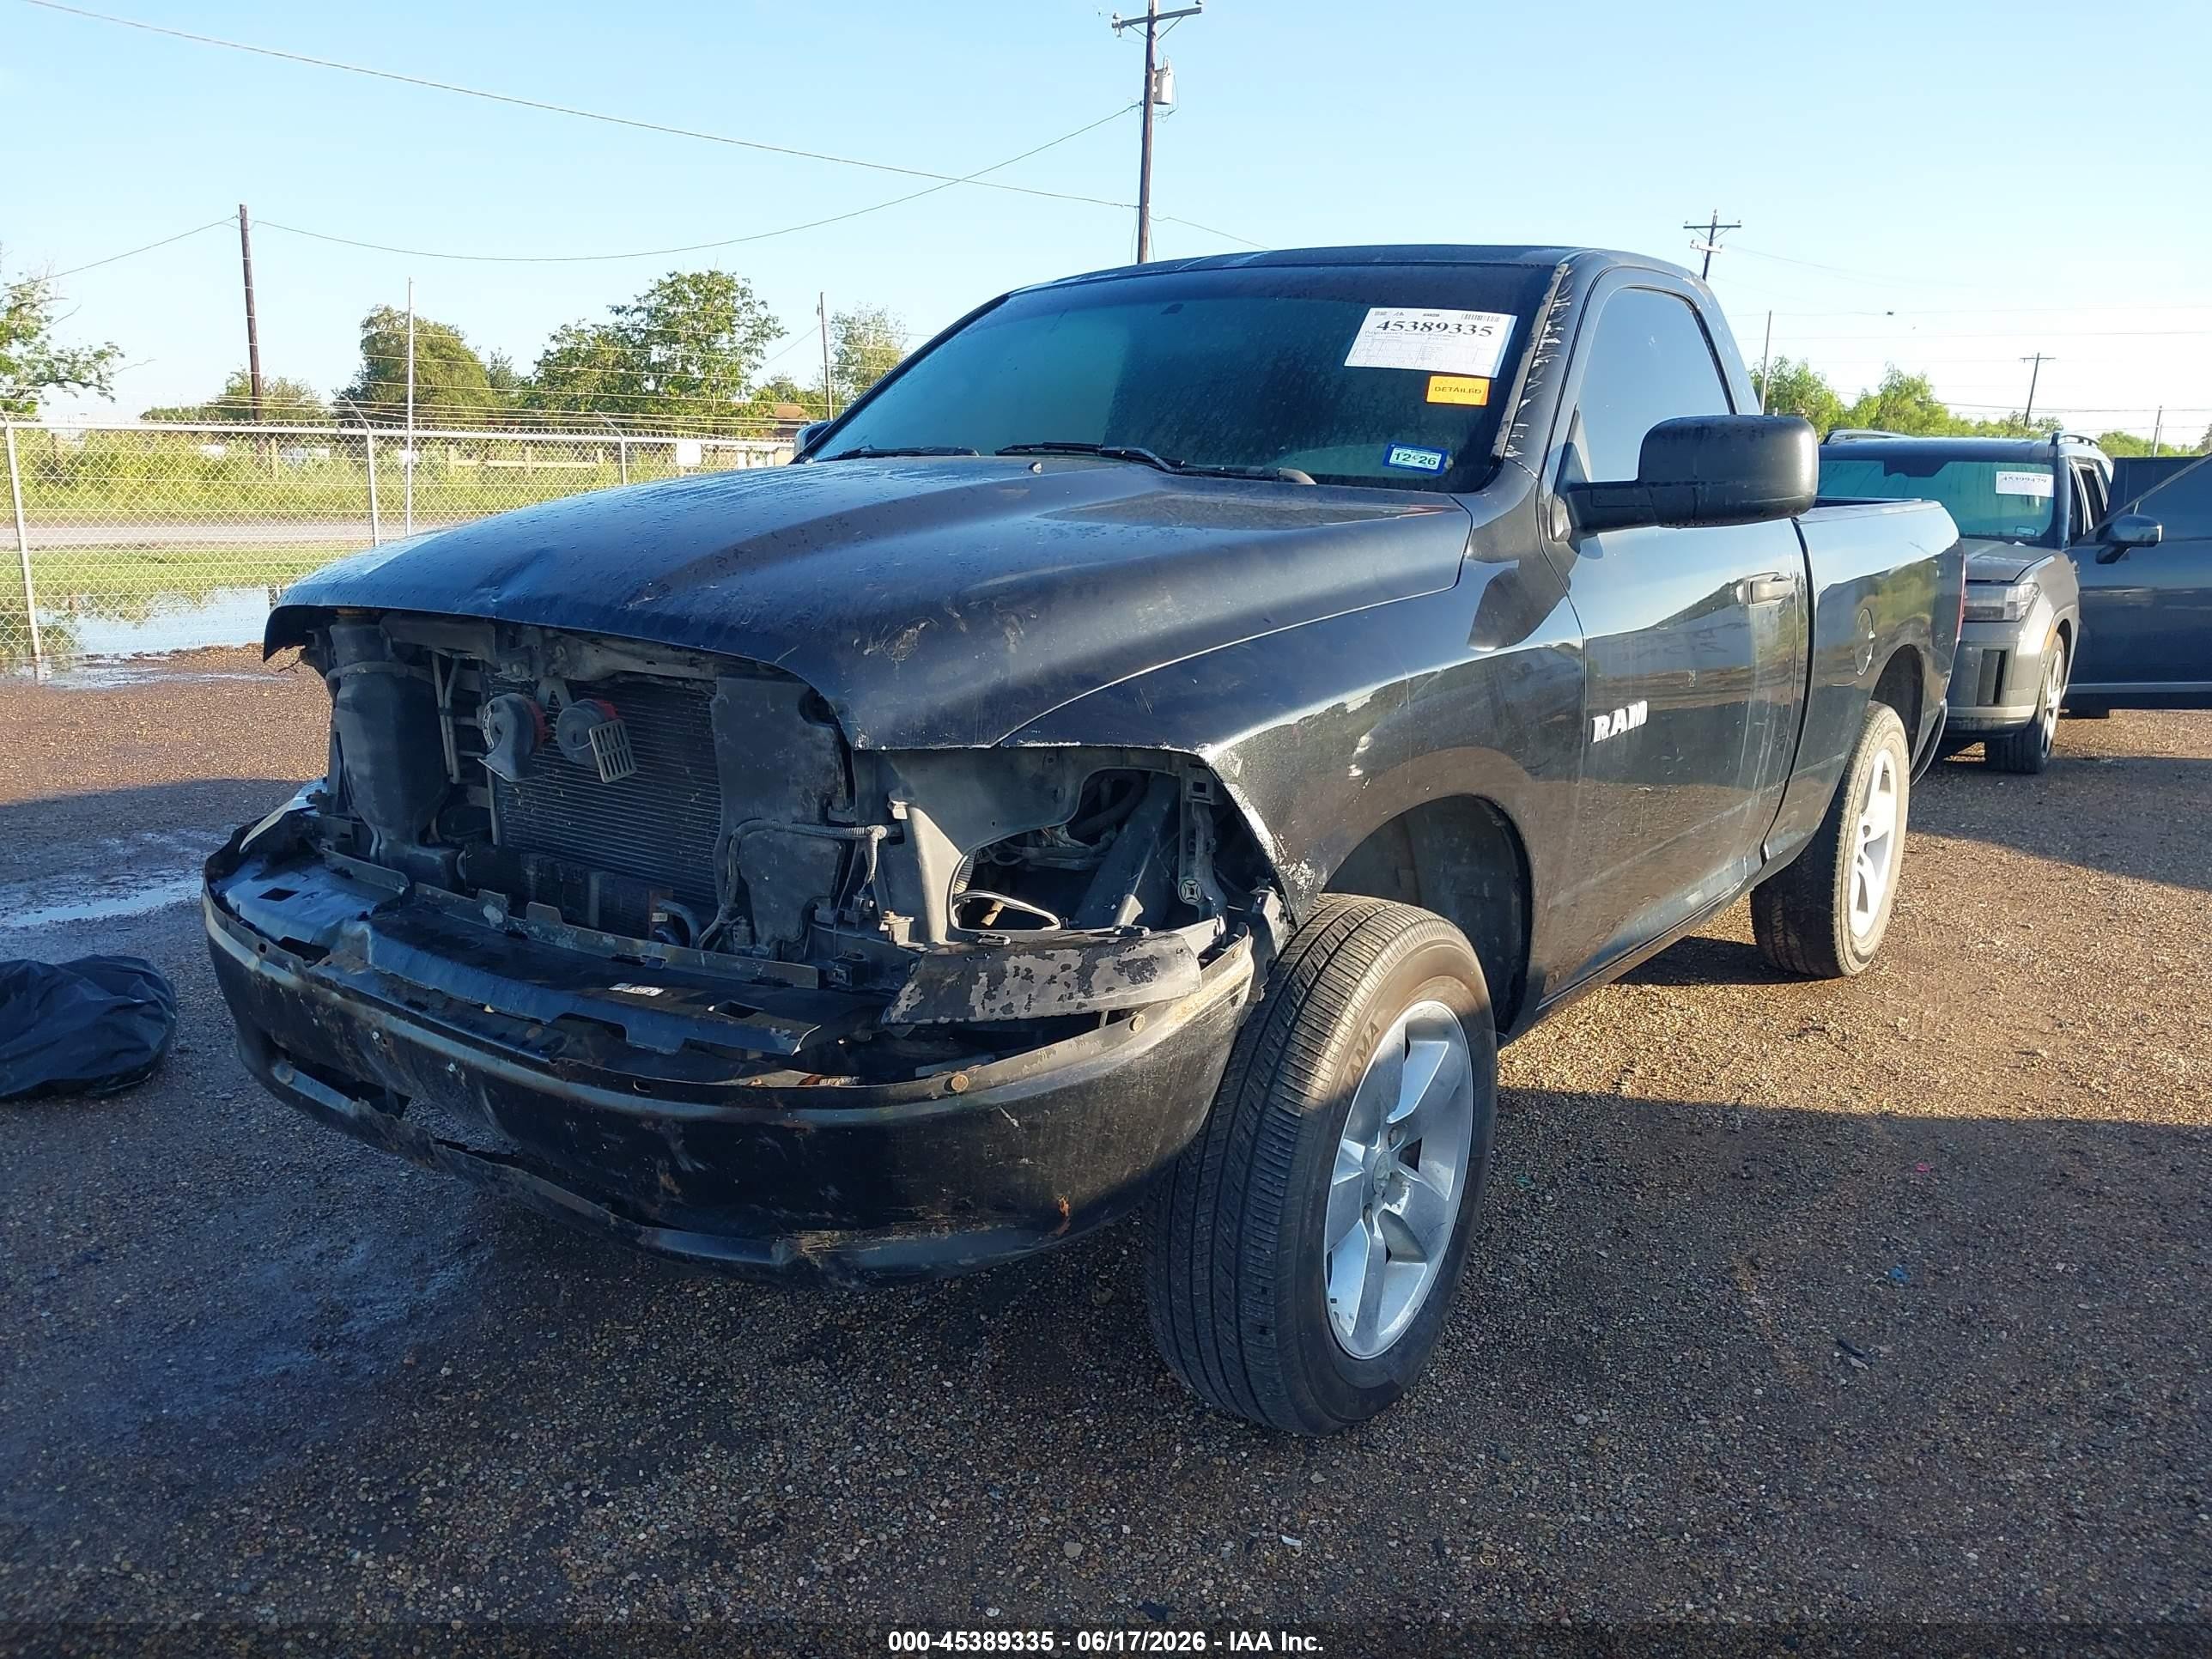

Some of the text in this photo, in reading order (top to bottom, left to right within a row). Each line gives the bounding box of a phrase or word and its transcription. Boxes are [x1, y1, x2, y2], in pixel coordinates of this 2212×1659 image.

[1376, 320, 1493, 337] 45389335
[1395, 453, 1412, 462] 12
[1419, 455, 1437, 465] 26
[1589, 701, 1648, 744] RAM
